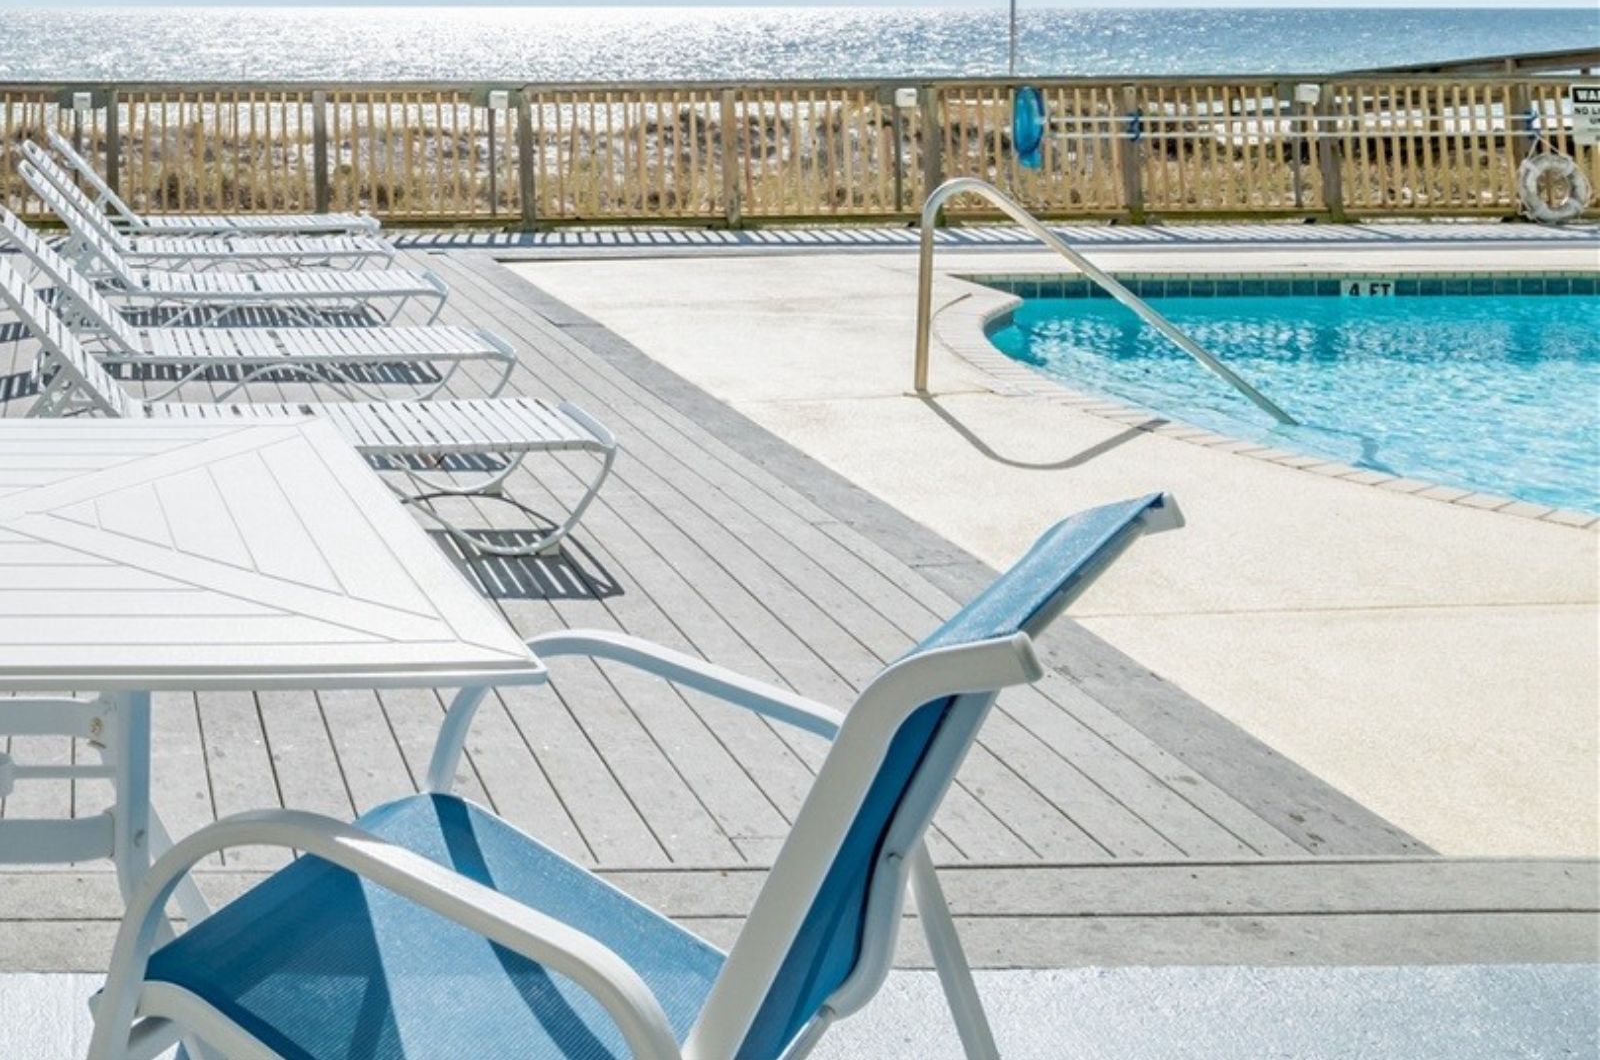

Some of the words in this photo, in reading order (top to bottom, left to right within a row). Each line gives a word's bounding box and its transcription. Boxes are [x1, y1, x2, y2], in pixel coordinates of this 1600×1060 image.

[1574, 106, 1589, 115] NO
[1349, 282, 1360, 296] 4
[1369, 283, 1391, 297] FT
